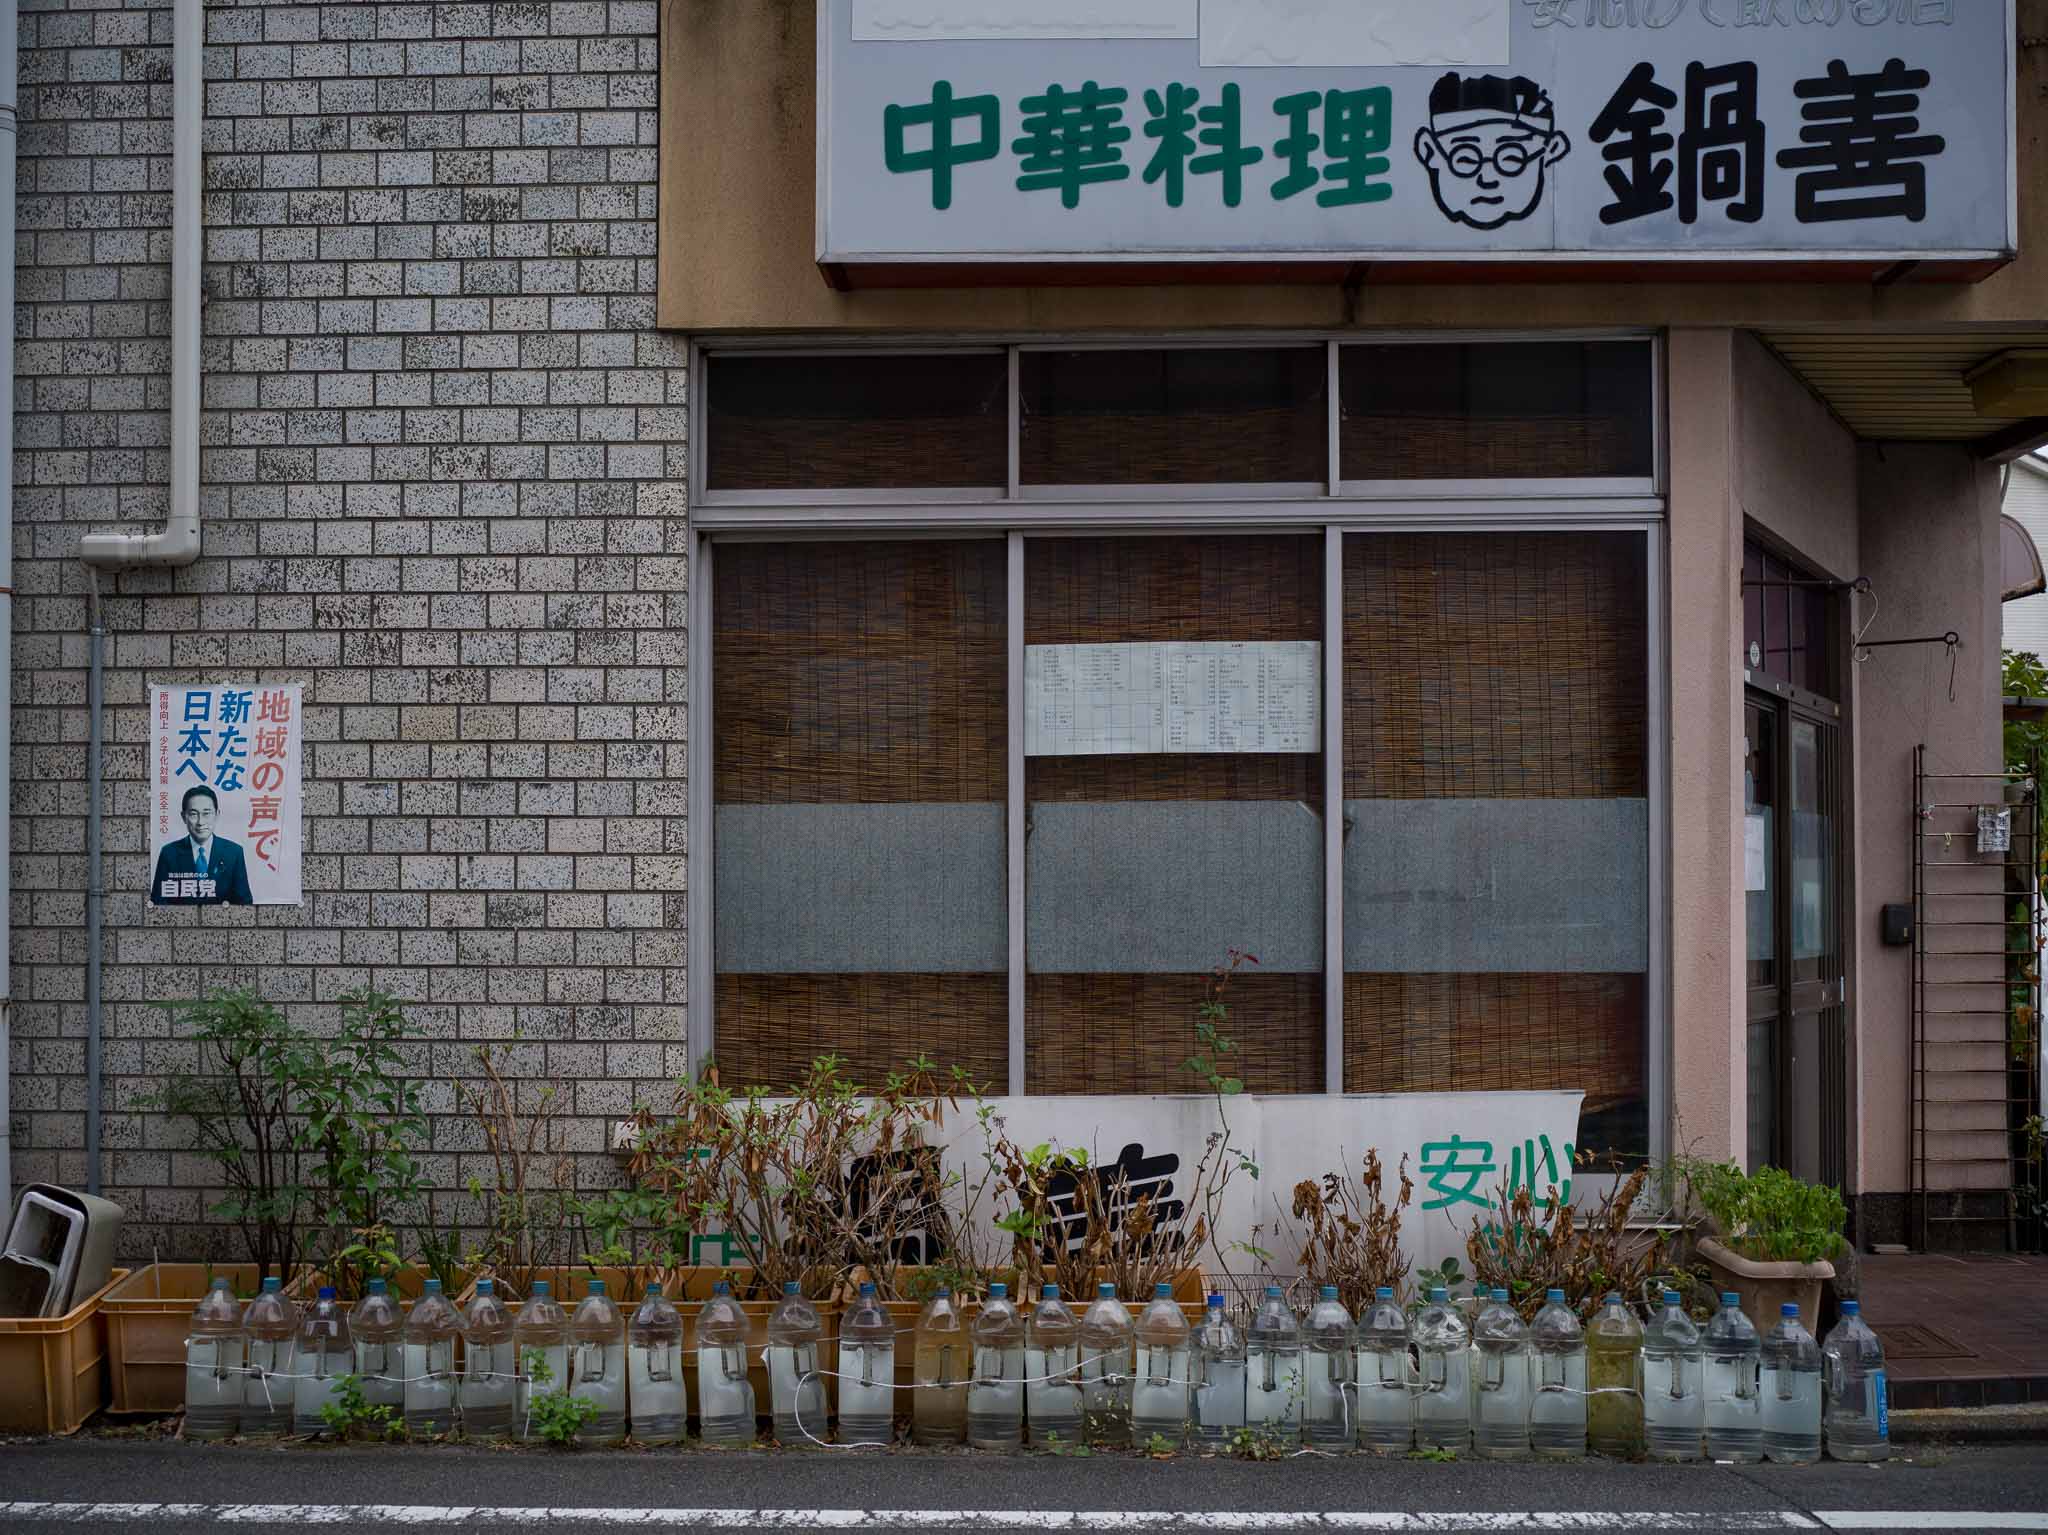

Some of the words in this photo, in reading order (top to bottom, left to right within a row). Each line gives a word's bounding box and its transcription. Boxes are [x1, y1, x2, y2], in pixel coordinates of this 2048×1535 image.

[884, 79, 1394, 210] 中華料理
[1588, 58, 1946, 225] 鍋善
[159, 691, 169, 730] 所得向上
[175, 691, 212, 782] 日本へ
[214, 690, 253, 792] 新たな
[247, 690, 291, 872] 地域の声で、
[161, 879, 217, 898] 自民党
[1419, 1134, 1575, 1210] 安心
